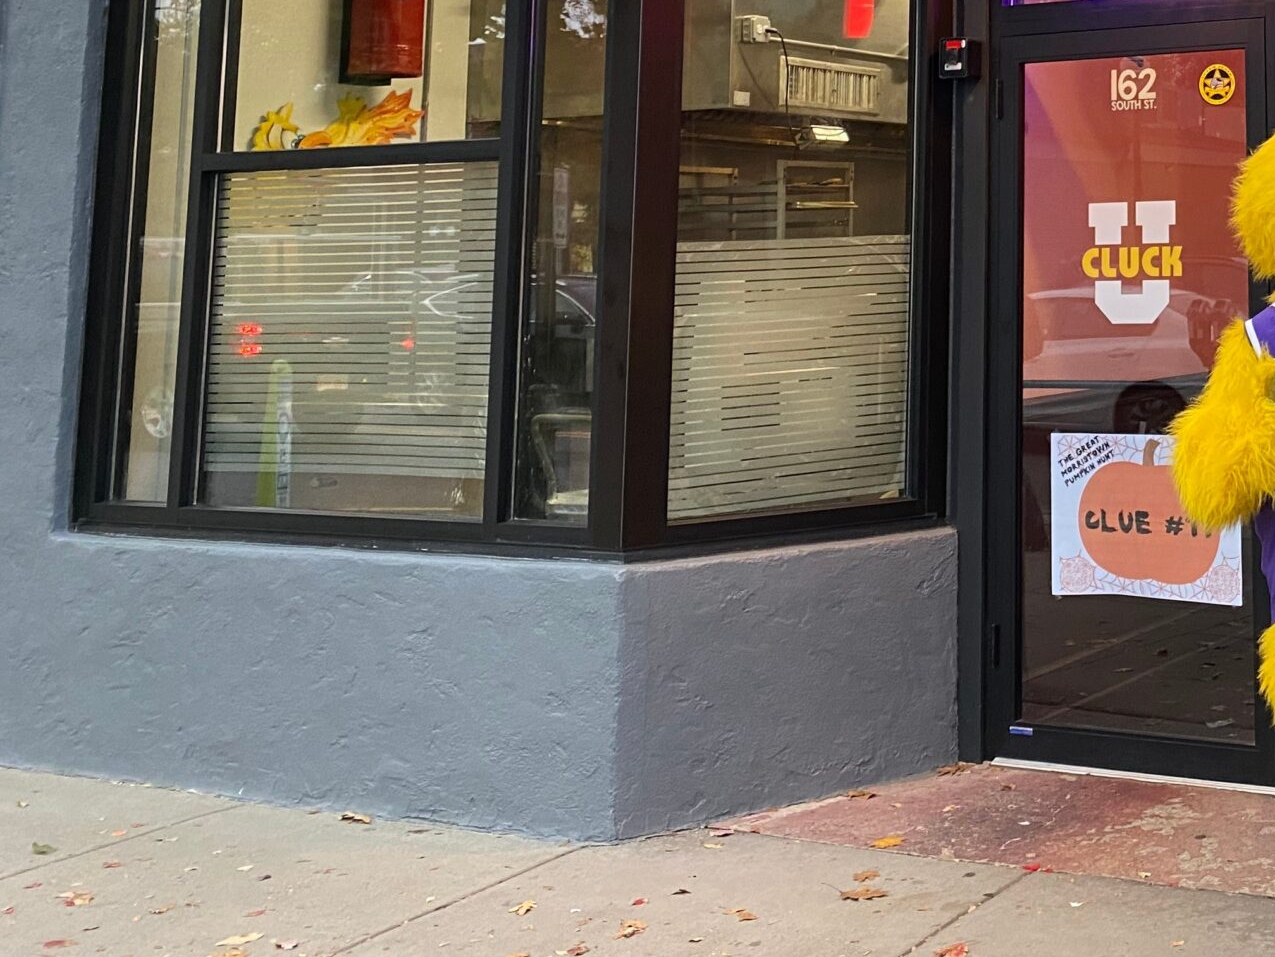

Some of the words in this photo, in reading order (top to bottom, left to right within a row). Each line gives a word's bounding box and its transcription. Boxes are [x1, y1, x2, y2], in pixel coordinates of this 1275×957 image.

[1110, 67, 1157, 101] 162
[1111, 100, 1142, 112] SOUTH
[1143, 99, 1158, 110] ST.
[1081, 245, 1183, 278] CLUCK
[1058, 453, 1075, 467] THE
[1075, 435, 1100, 456] GREAT
[1060, 440, 1110, 478] MORRISTOWN
[1064, 462, 1096, 487] PUMPKIN
[1096, 448, 1115, 465] HUNT
[1085, 508, 1153, 534] CLUE
